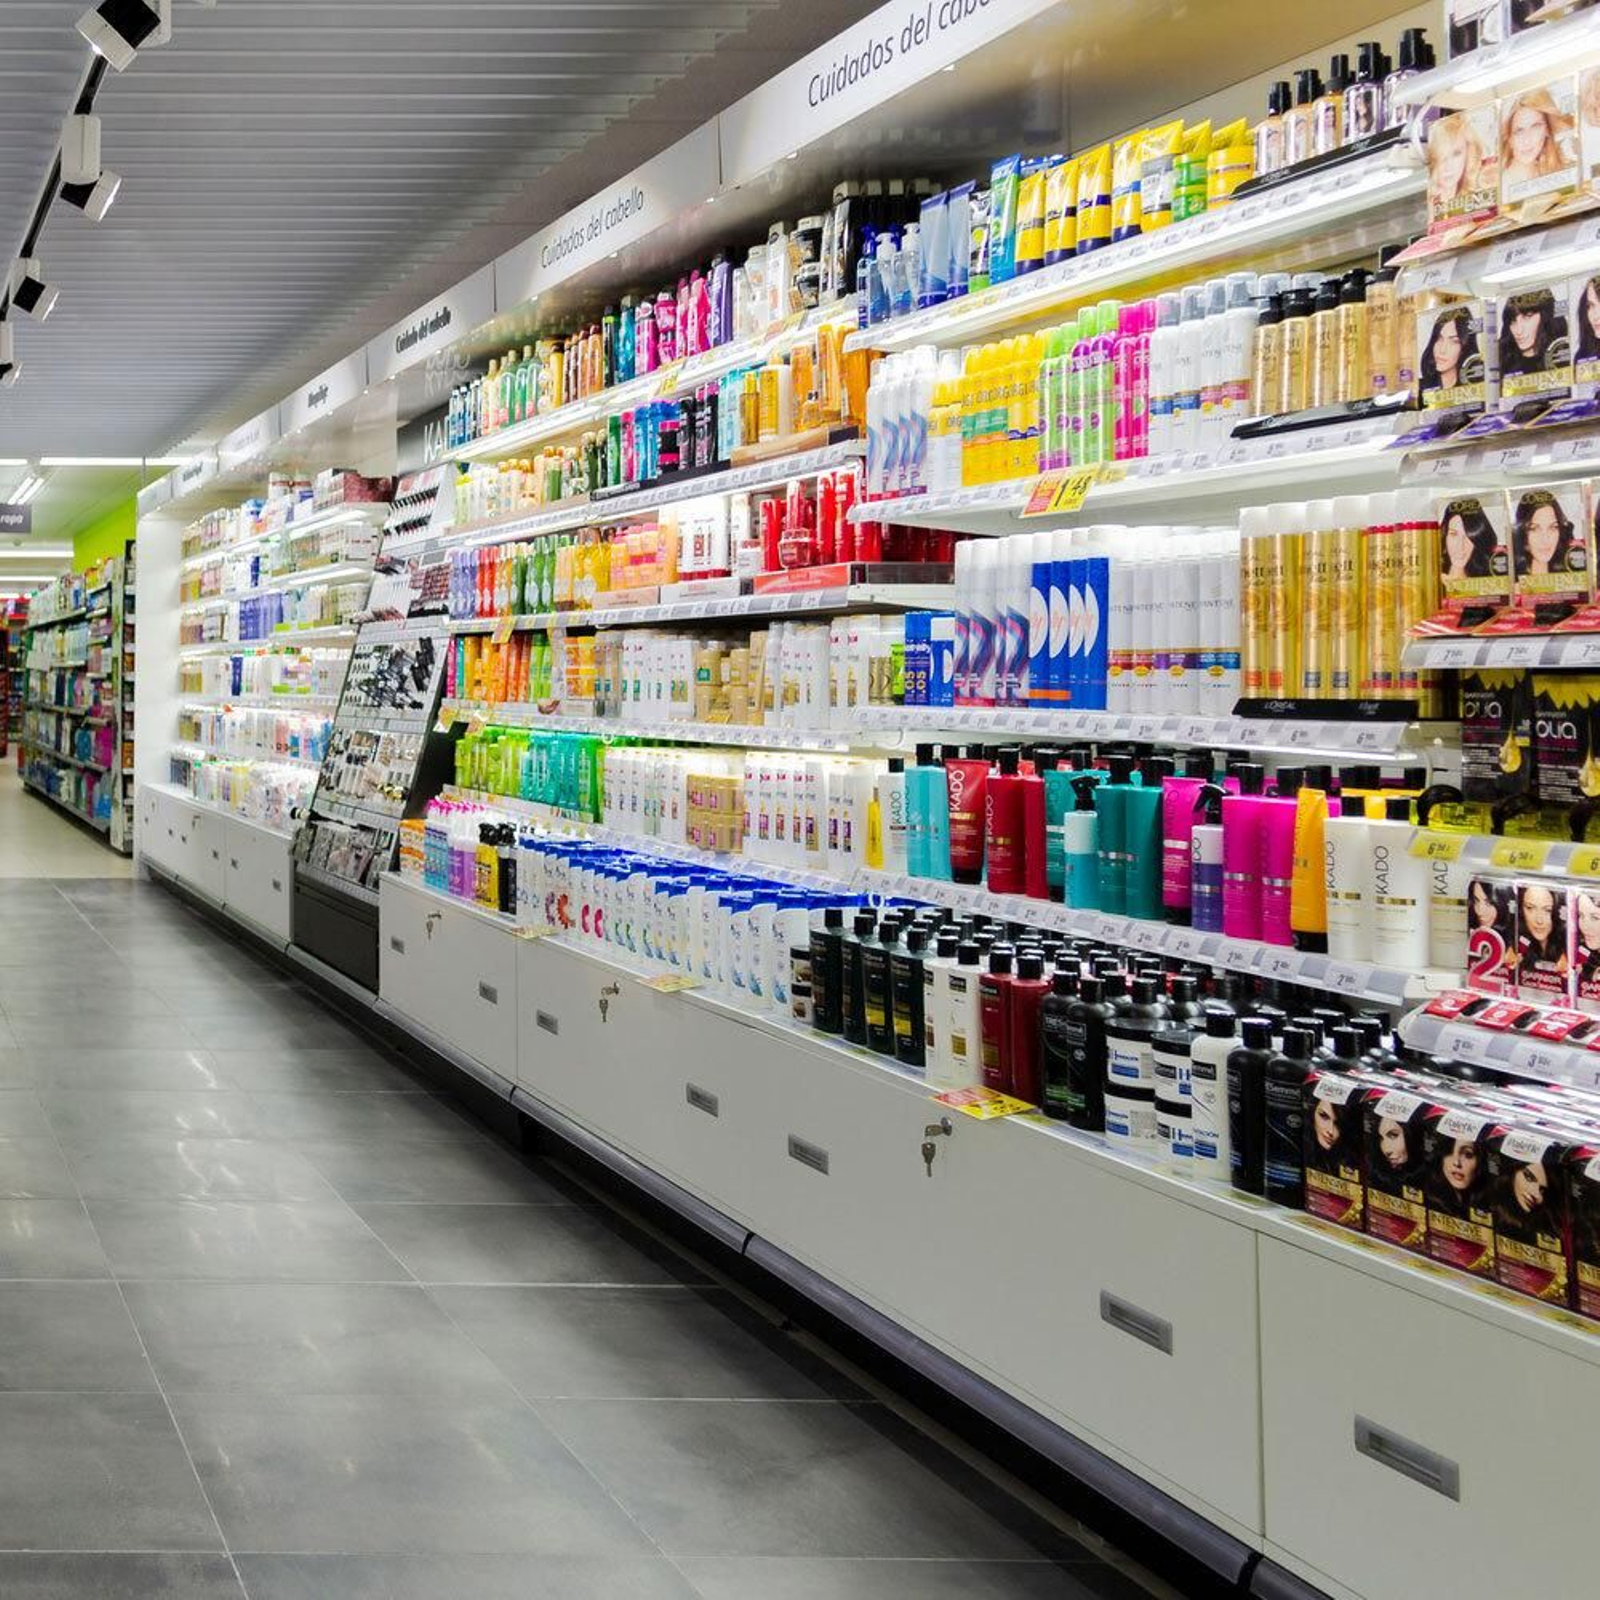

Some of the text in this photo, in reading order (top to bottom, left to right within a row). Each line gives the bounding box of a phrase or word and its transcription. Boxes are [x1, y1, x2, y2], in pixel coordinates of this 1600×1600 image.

[808, 36, 894, 107] Cuidados
[900, 2, 933, 54] del
[541, 186, 644, 269] Cuidados del cabello
[949, 769, 966, 812] KADO
[1375, 845, 1390, 896] KADO
[1432, 861, 1449, 896] KAD
[1467, 926, 1506, 996] 2
[1429, 1211, 1483, 1241] INTENSIVE
[1498, 1235, 1552, 1267] INTENSIVE
